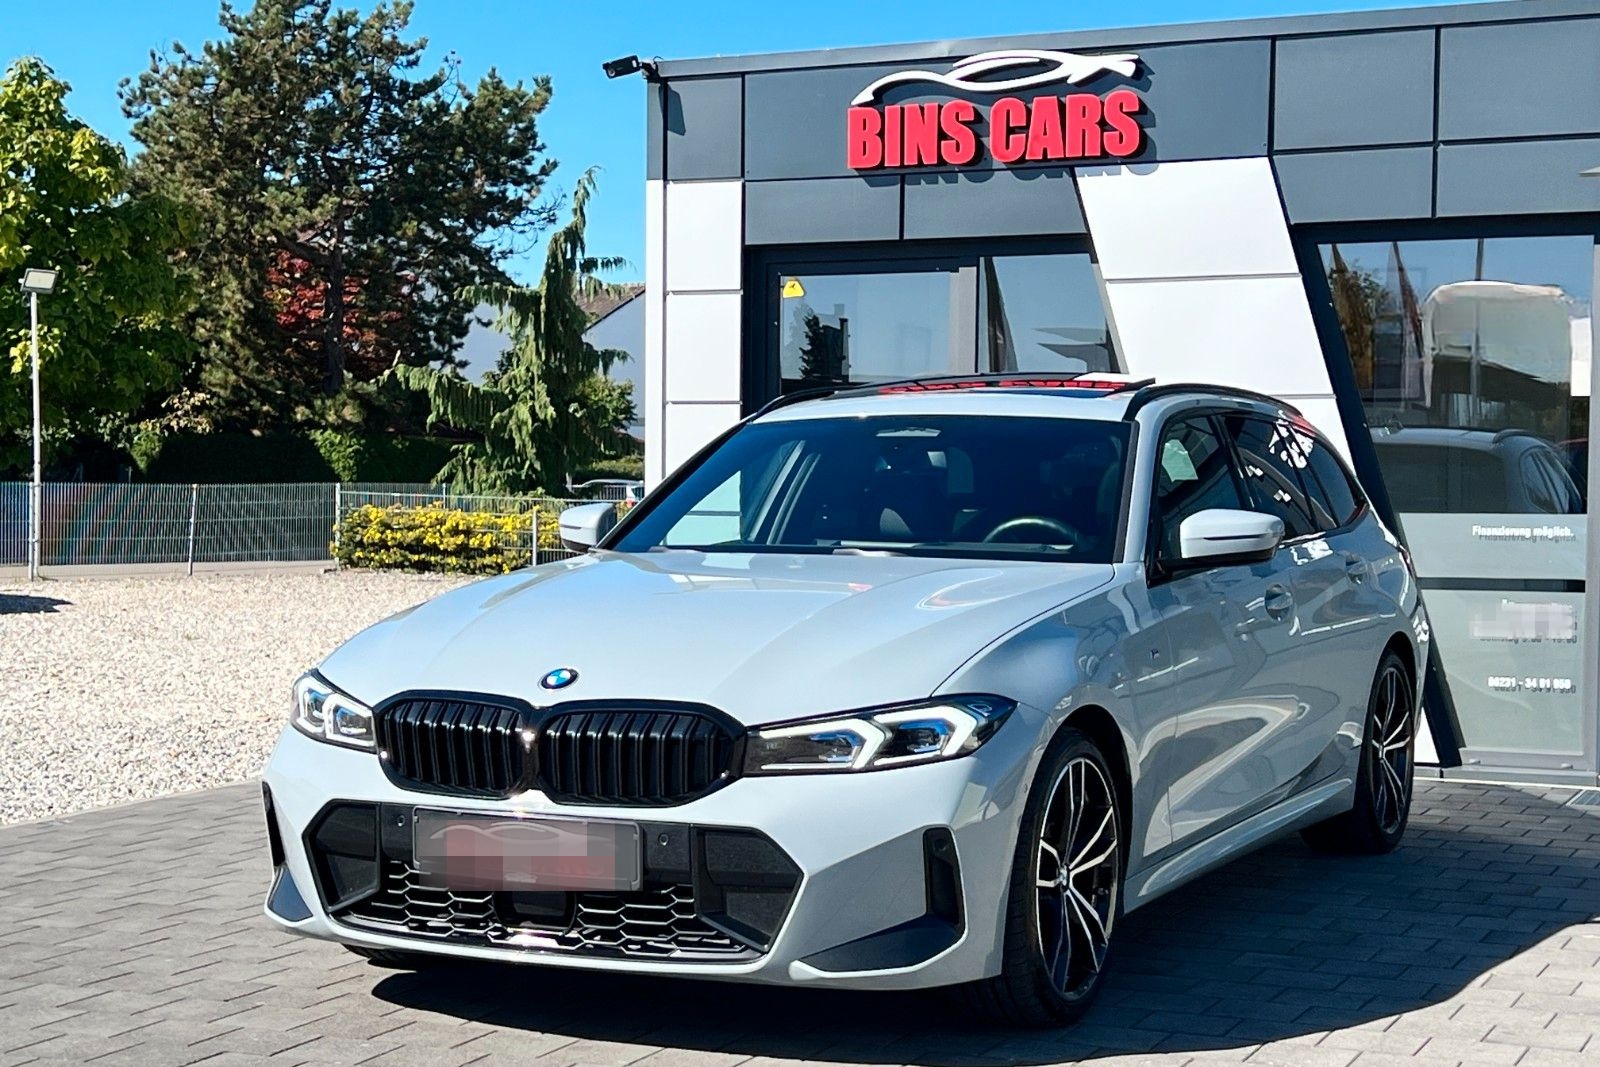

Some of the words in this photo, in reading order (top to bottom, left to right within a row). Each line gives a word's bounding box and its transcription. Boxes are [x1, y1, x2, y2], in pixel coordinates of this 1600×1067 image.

[847, 100, 976, 169] BINS
[990, 90, 1140, 162] CARS
[1472, 525, 1531, 538] Finanzierung
